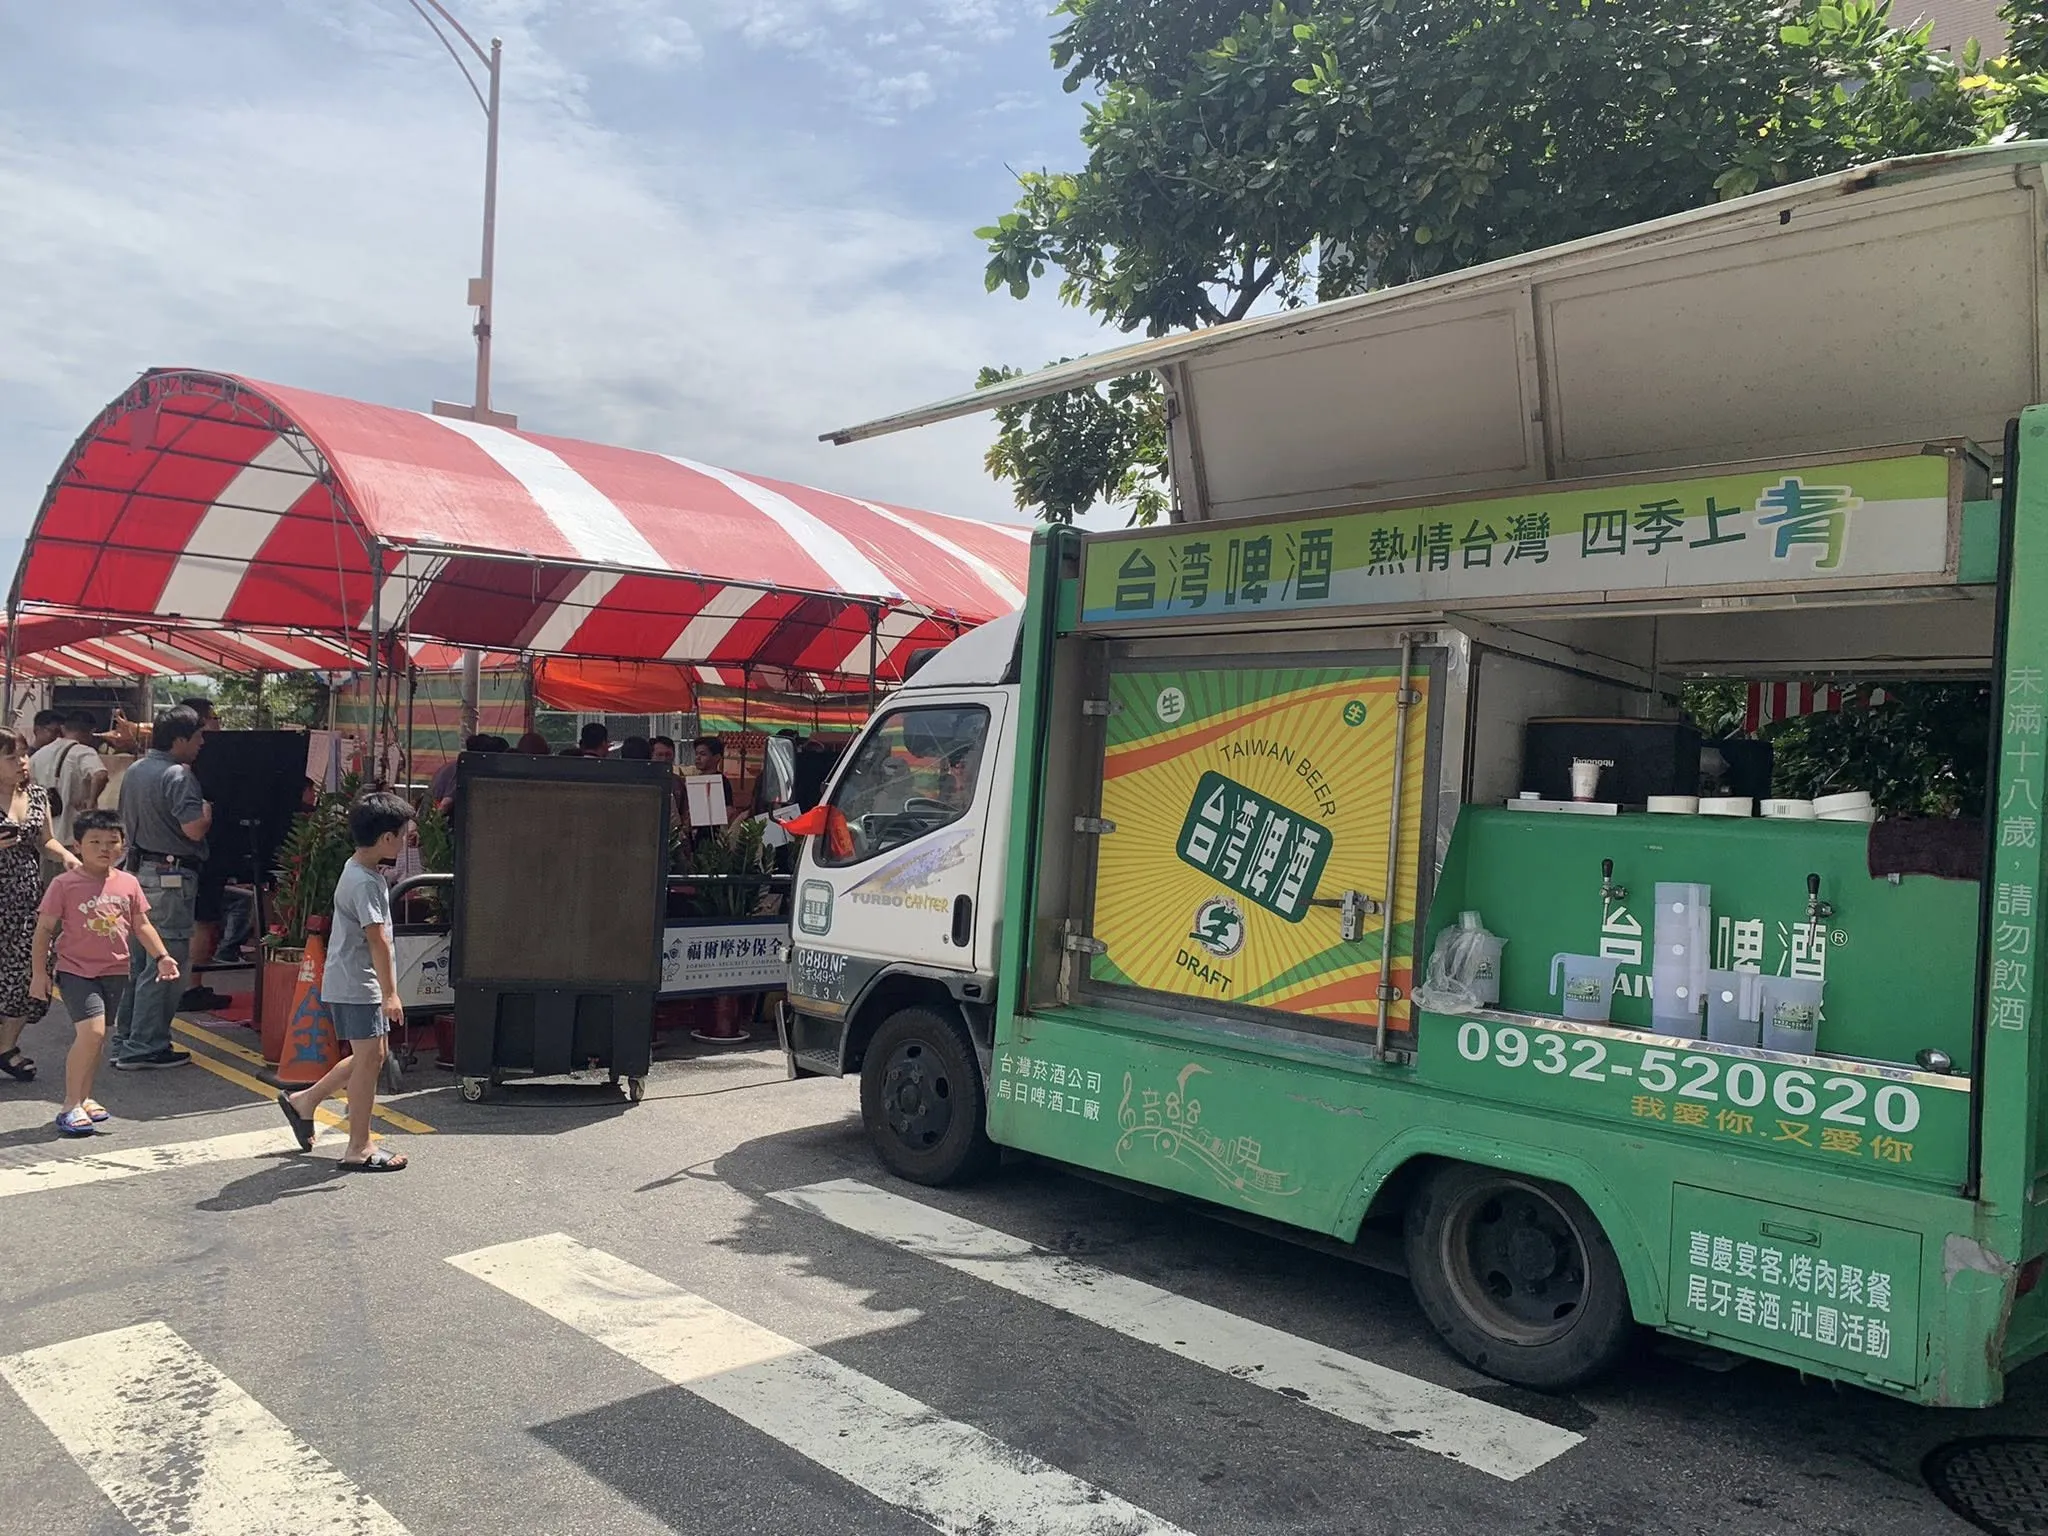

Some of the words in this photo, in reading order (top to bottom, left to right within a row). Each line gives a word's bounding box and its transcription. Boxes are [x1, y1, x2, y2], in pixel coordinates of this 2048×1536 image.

[1114, 528, 1333, 612] 台湾啤酒
[1366, 511, 1551, 577] 熱情台灣
[1581, 477, 1863, 573] 四季上青
[1162, 692, 1181, 716] 生
[1344, 704, 1364, 724] 生
[1220, 740, 1295, 766] TAIWAN
[1296, 758, 1336, 818] BEER
[850, 892, 903, 907] TURBO
[904, 892, 949, 913] CANTER
[686, 937, 783, 960] 福爾摩沙保全
[1600, 905, 1827, 982] 台啤酒
[1176, 949, 1232, 993] DRAFT
[999, 1053, 1102, 1094] 台灣菸酒公司
[1456, 1021, 1921, 1133] 0932-520620
[997, 1079, 1100, 1121] 烏日啤酒工廠
